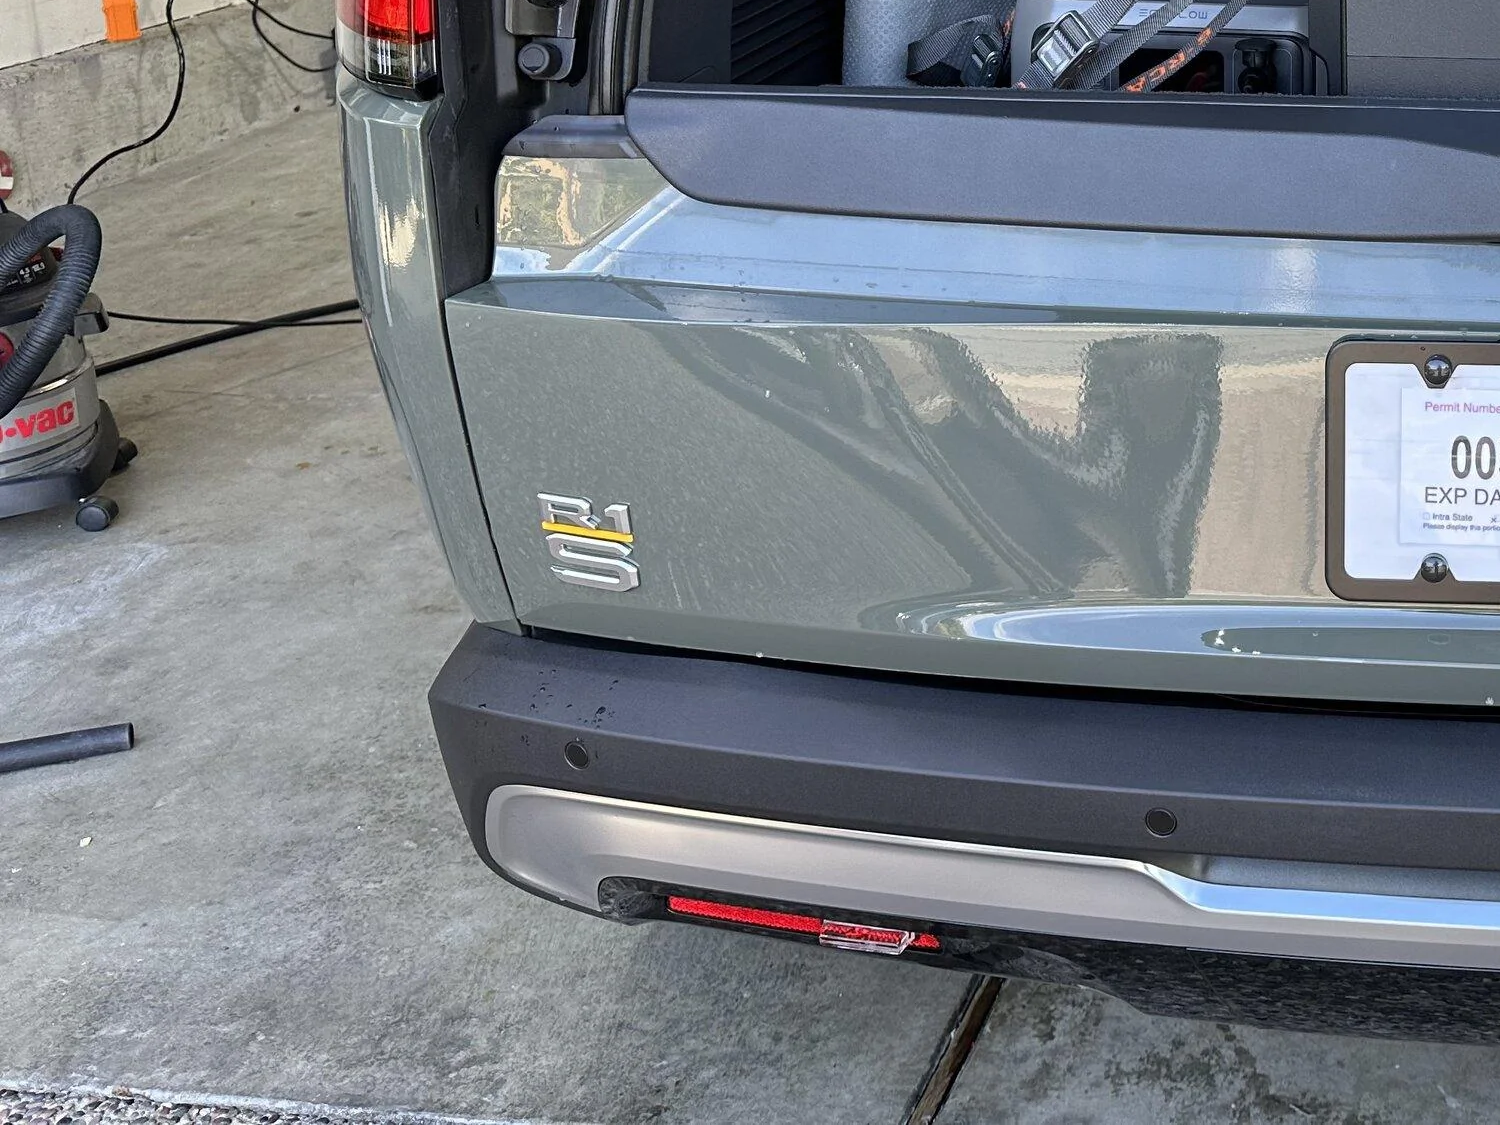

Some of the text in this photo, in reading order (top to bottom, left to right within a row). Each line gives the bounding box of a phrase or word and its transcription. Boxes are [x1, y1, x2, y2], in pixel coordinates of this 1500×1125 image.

[1424, 401, 1460, 413] Permit
[1424, 486, 1468, 505] EXP
[1432, 512, 1451, 522] Intra
[1452, 513, 1474, 523] State
[1422, 522, 1445, 530] Please
[1445, 523, 1470, 532] display
[1469, 523, 1482, 531] this
